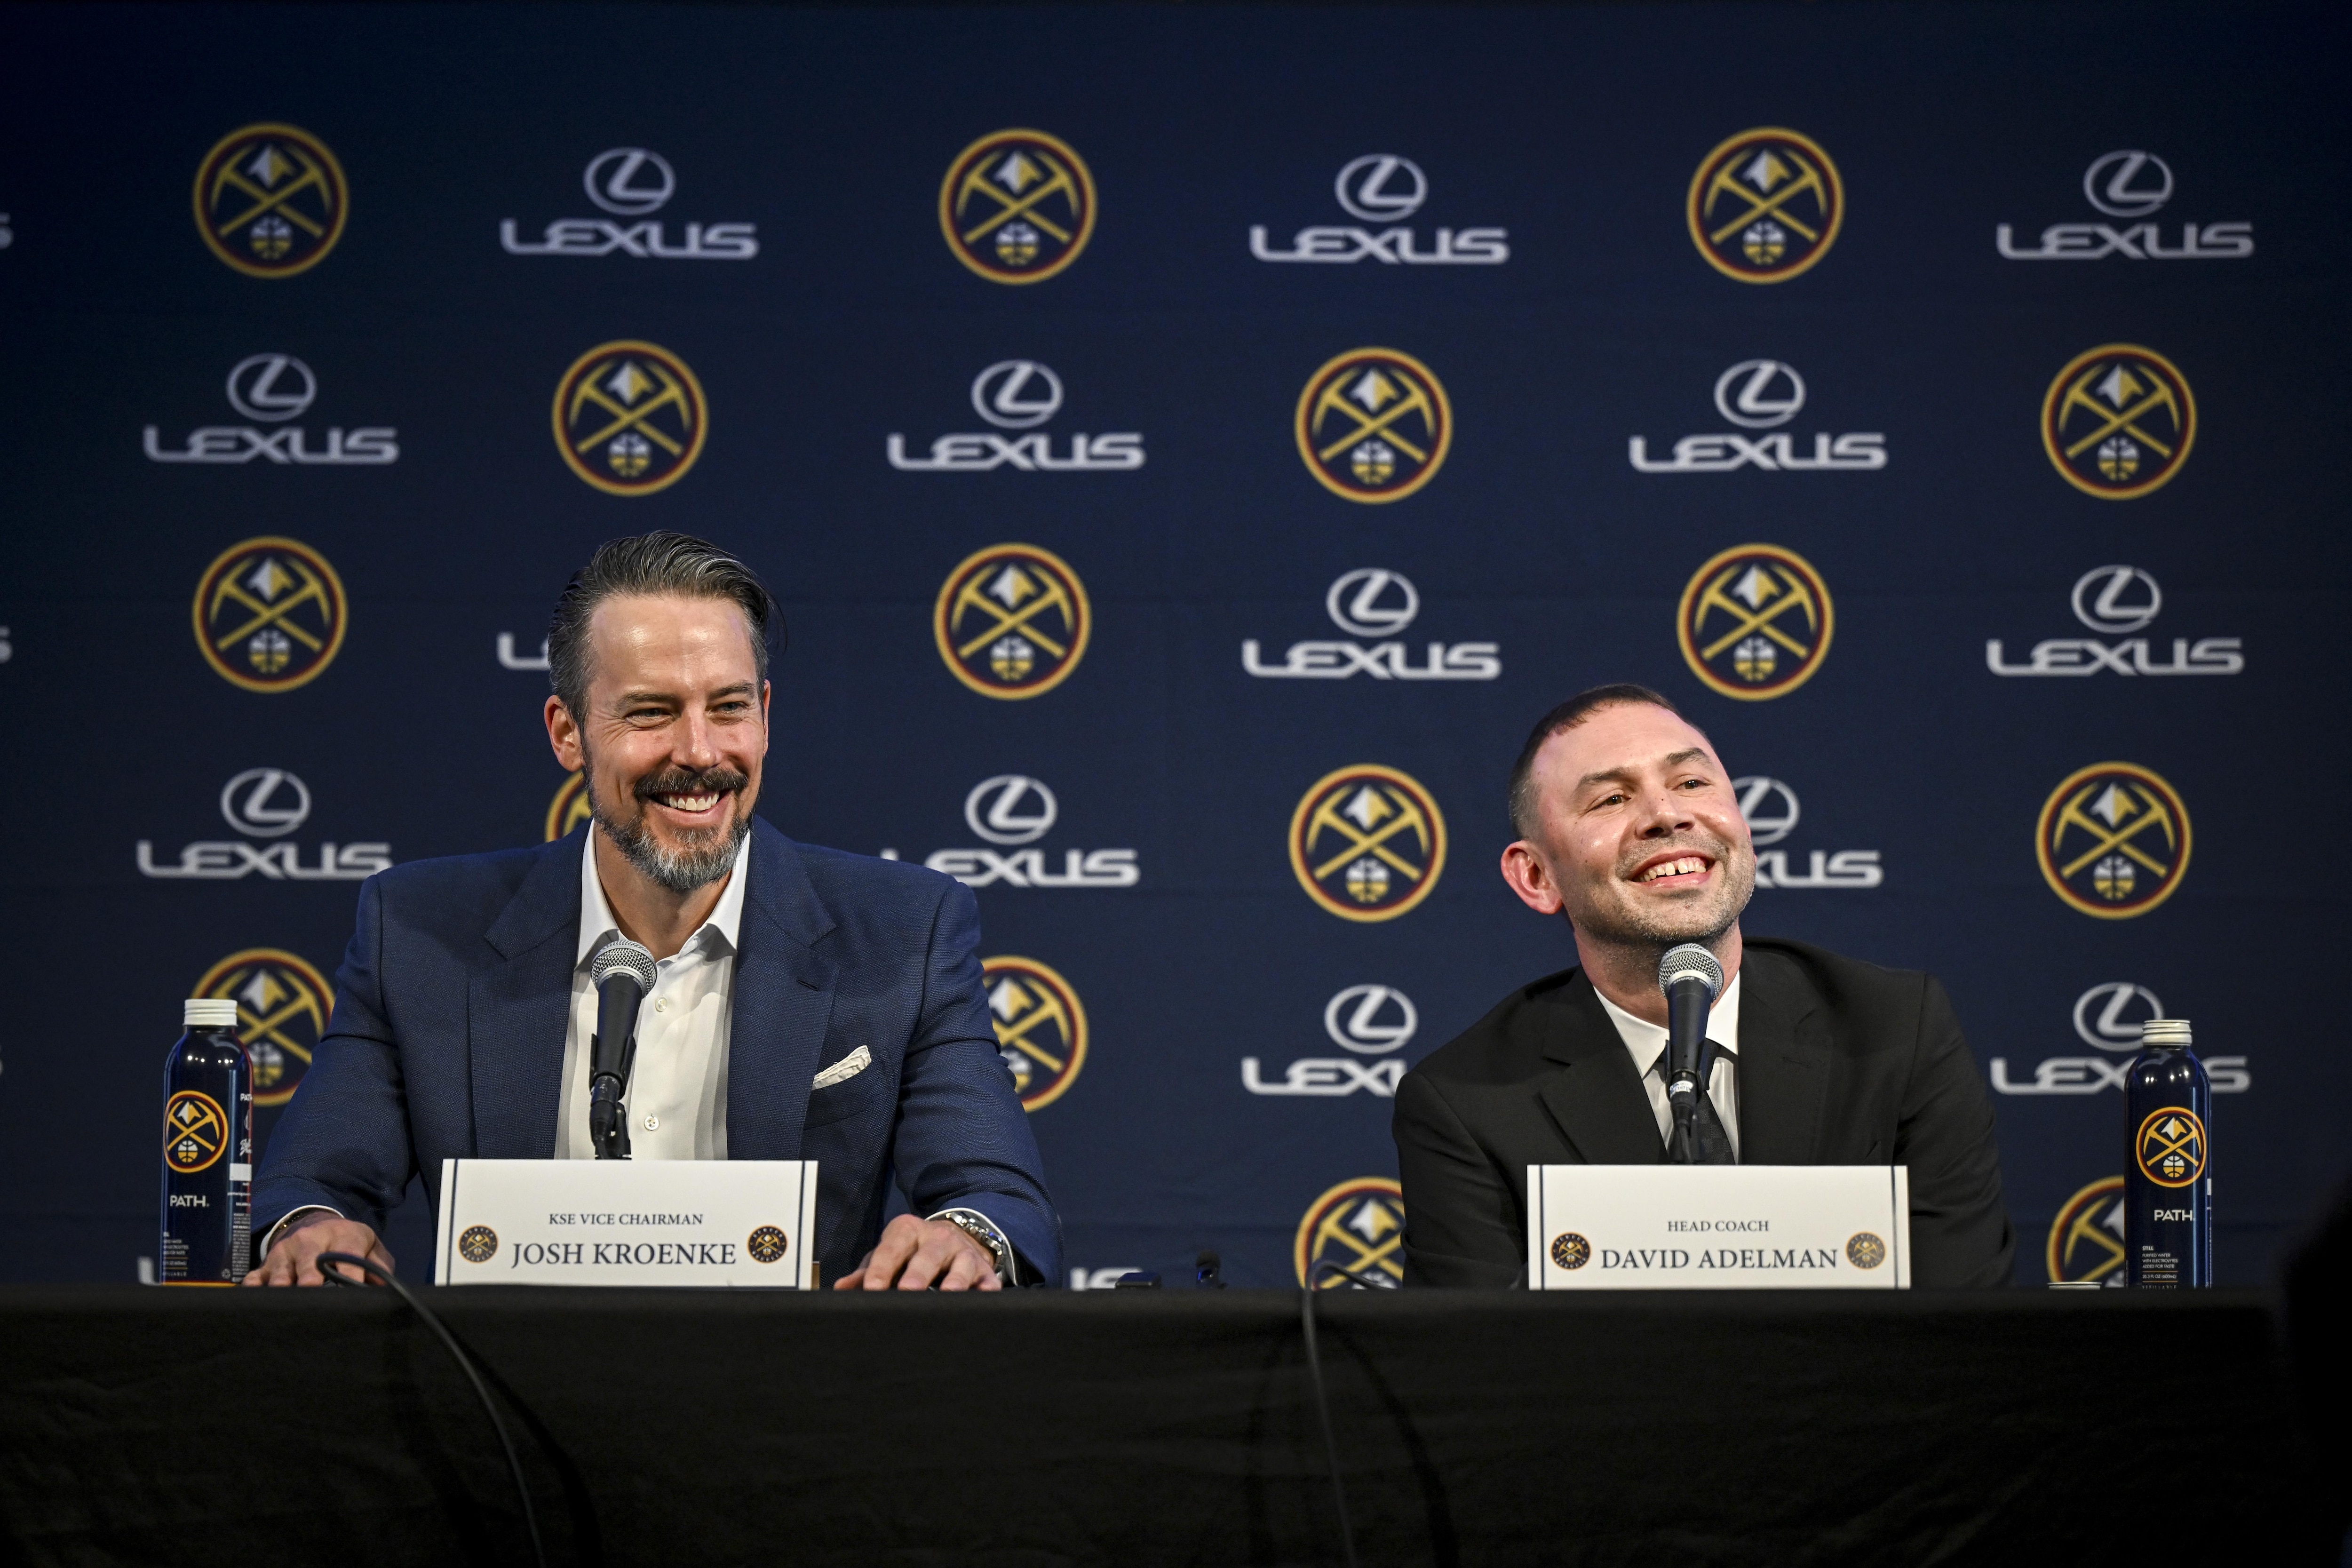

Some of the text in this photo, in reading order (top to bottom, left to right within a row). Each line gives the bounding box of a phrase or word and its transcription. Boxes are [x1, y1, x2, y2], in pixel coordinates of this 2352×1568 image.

[500, 219, 759, 260] LEXUS
[1249, 225, 1509, 264] LEXUS
[1995, 223, 2254, 260] LEXUS
[143, 426, 400, 464] LEXUS
[887, 433, 1145, 470] LEXUS
[1629, 433, 1887, 472] LEXUS
[1242, 640, 1501, 680] LEXUS
[1986, 639, 2244, 676] LEXUS
[137, 841, 392, 878] LEXUS
[881, 849, 1139, 886] EXUS
[1242, 1057, 1407, 1096] LEX
[1990, 1058, 2251, 1094] LEXS
[549, 1213, 703, 1225] KSE VICE CHAIRMAN
[1668, 1220, 1769, 1232] HEAD COACH
[511, 1243, 584, 1269] JOSH
[593, 1243, 736, 1265] KROENKE
[1602, 1250, 1689, 1268] DAVID
[1698, 1249, 1837, 1268] ADELMAN
